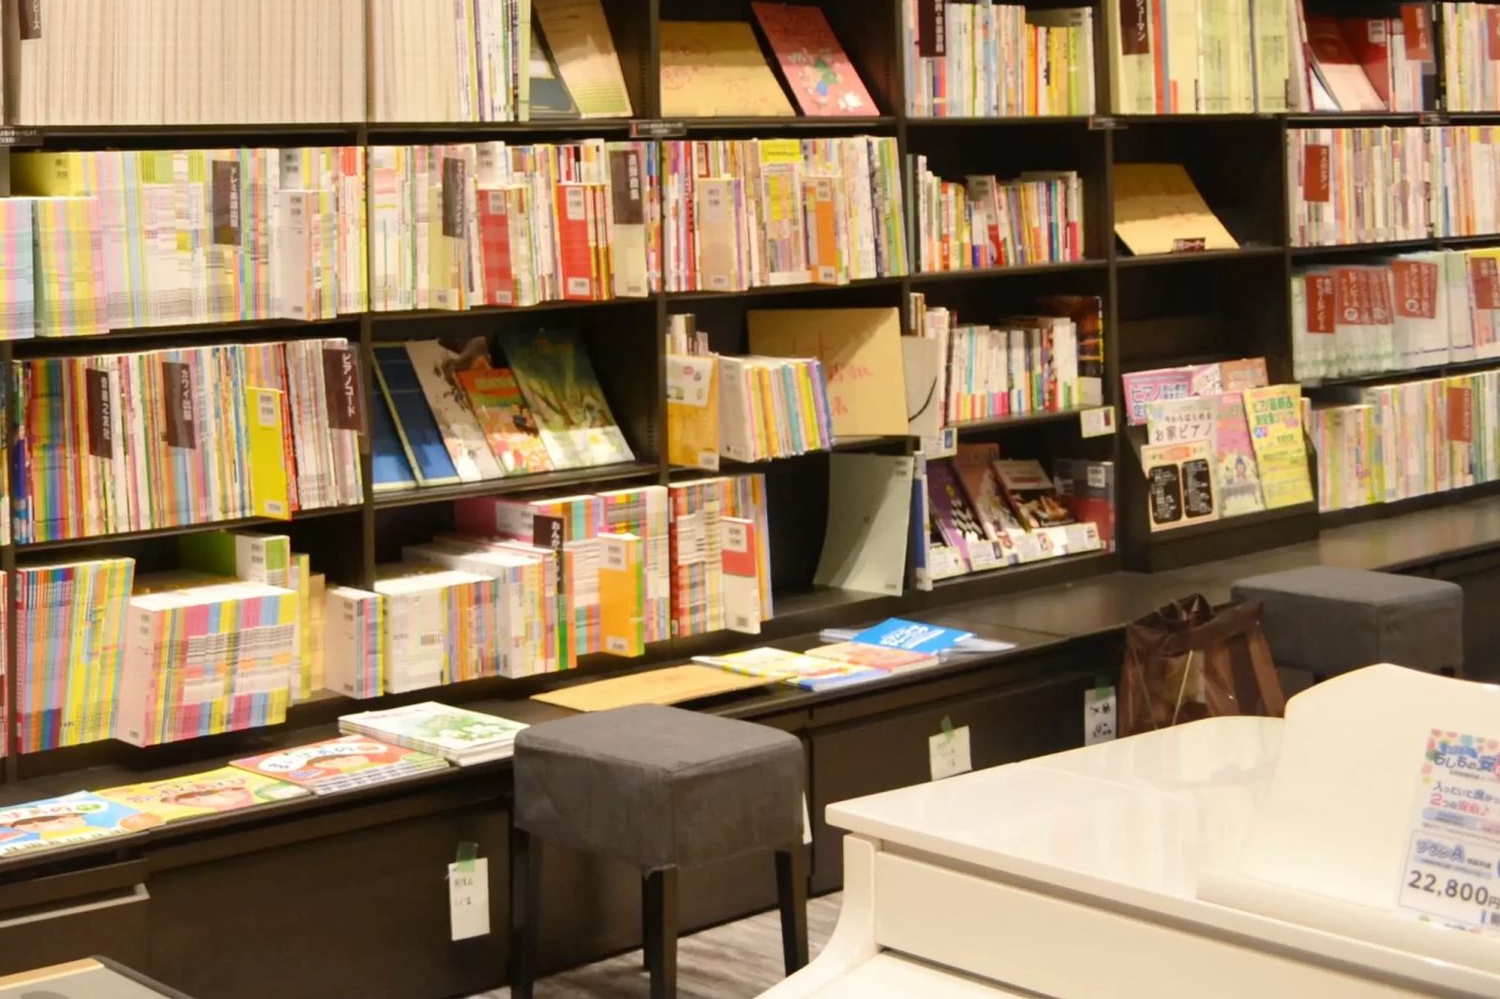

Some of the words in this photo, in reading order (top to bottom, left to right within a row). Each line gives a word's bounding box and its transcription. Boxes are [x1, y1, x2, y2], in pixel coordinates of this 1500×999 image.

[180, 368, 192, 422] カワイ出版
[1408, 870, 1500, 910] 22,800円
